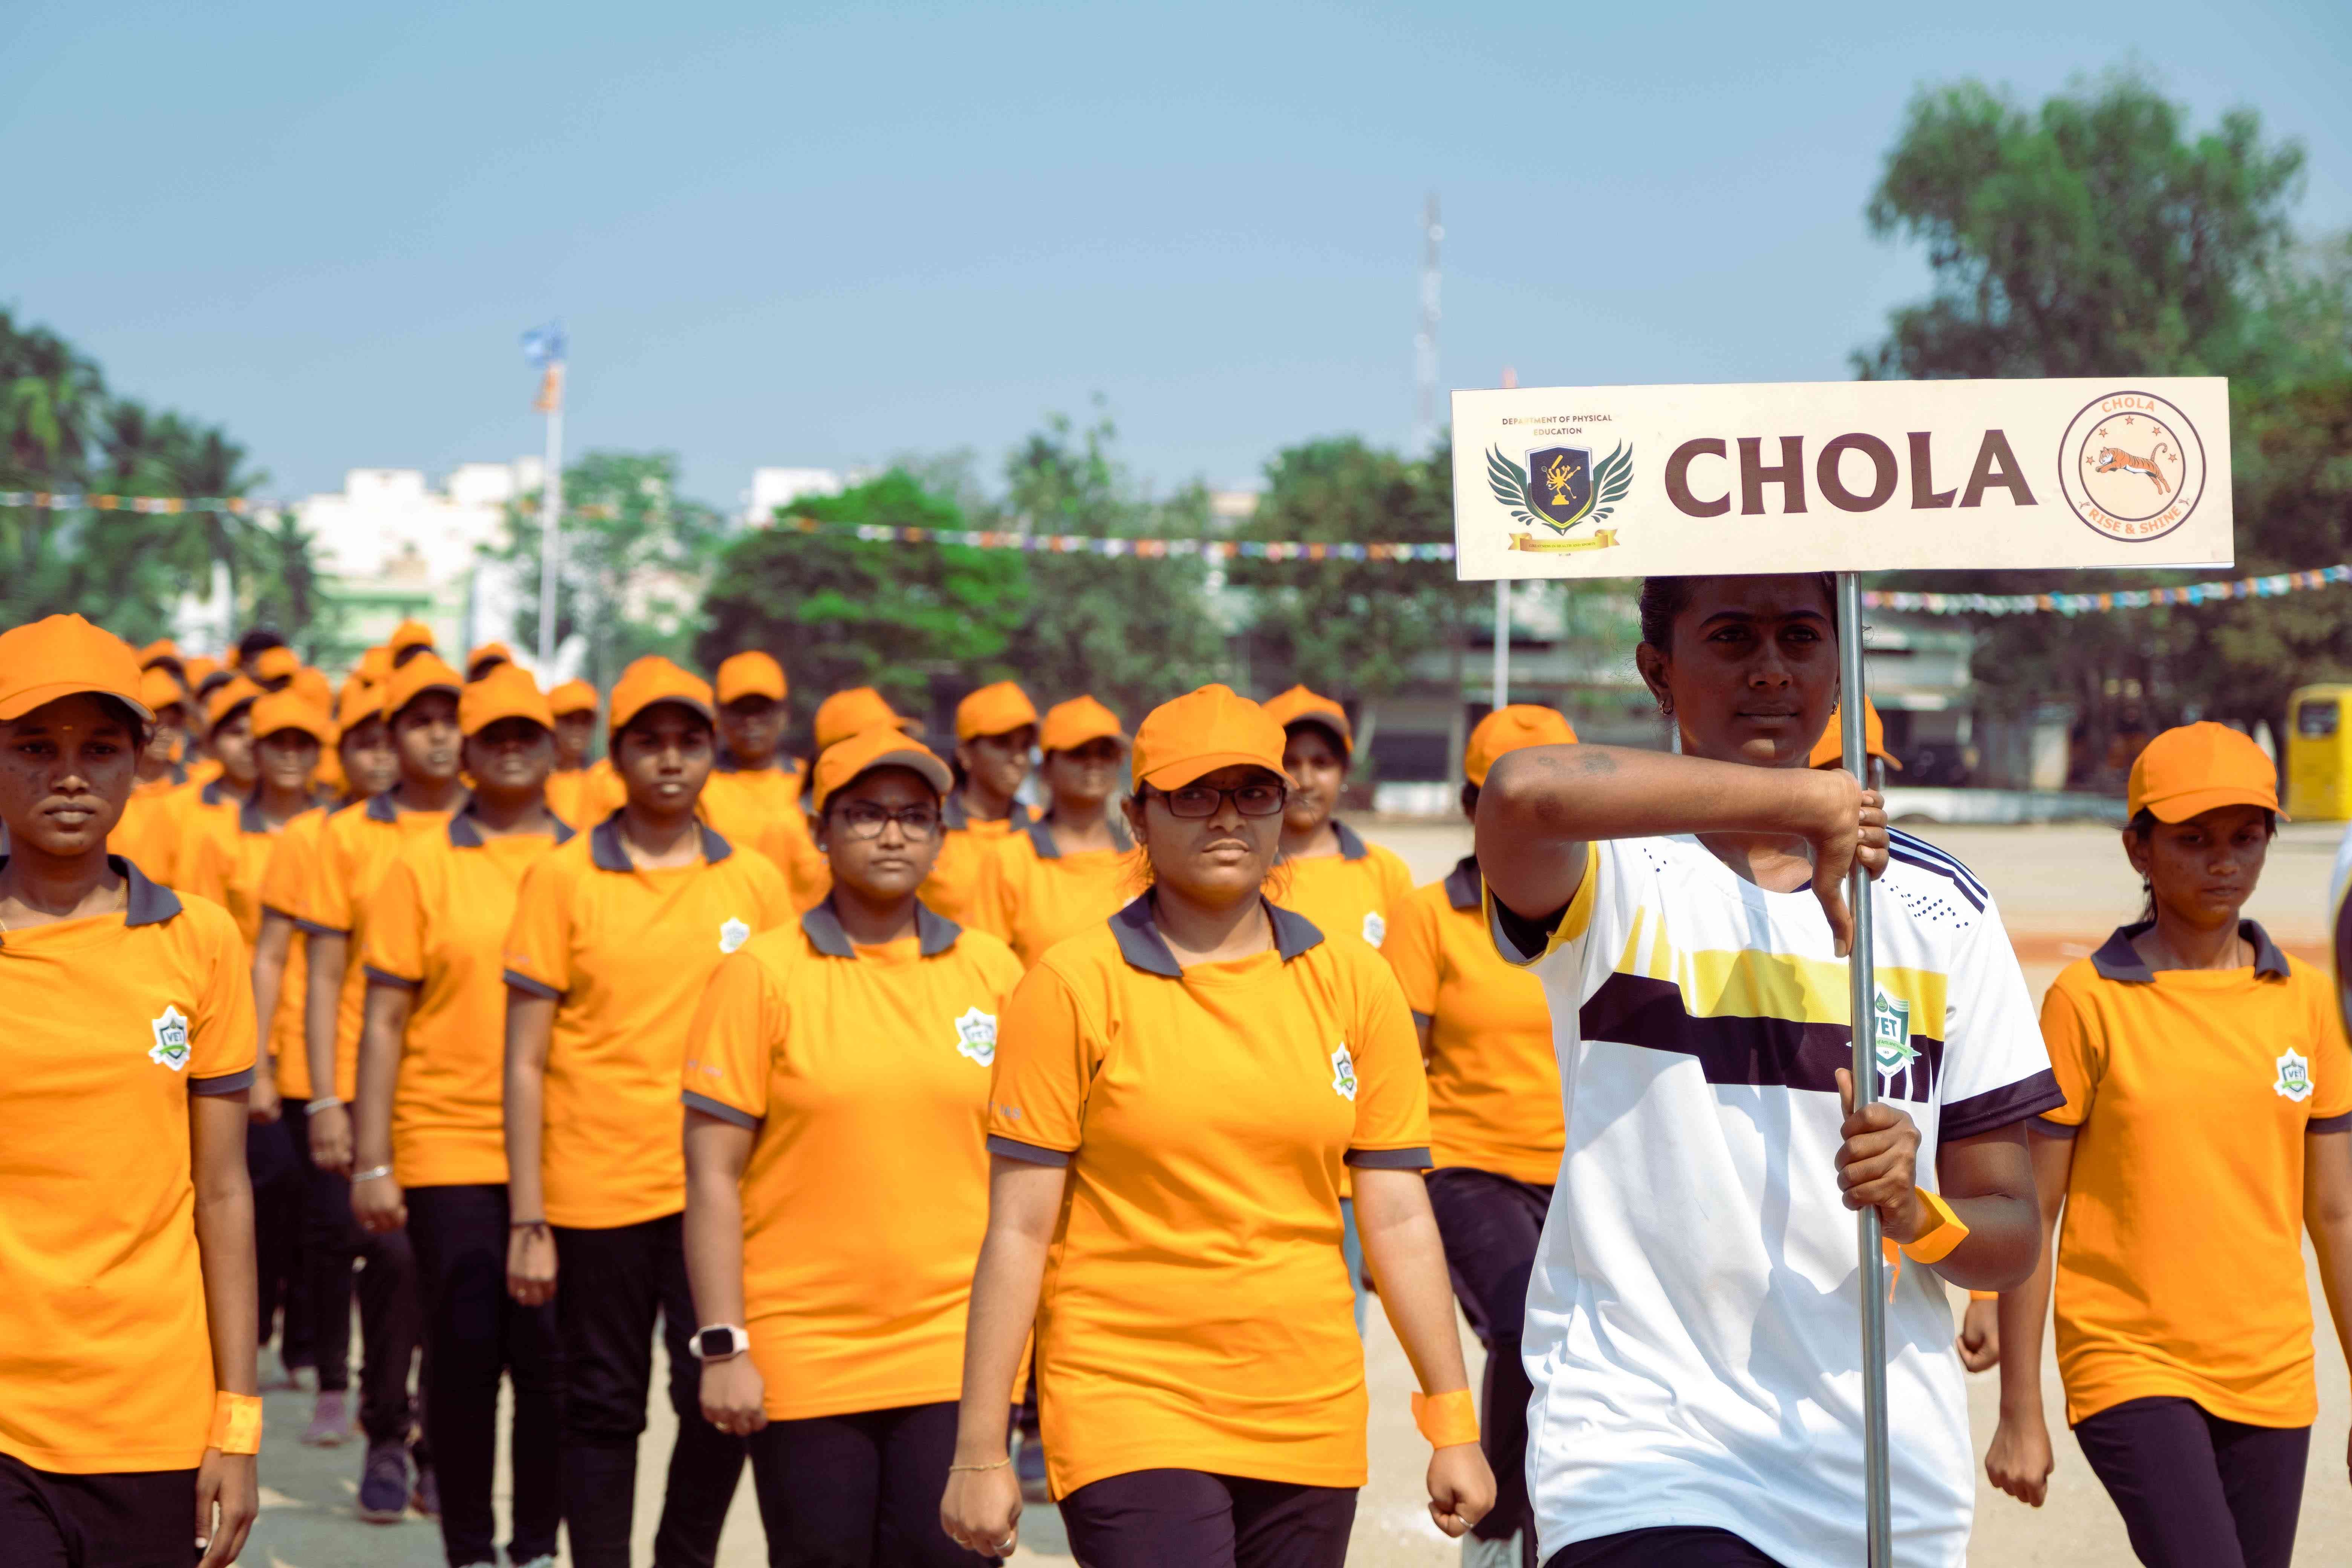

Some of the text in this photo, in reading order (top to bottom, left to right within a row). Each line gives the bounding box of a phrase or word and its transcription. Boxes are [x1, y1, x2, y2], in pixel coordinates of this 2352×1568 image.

[2102, 397, 2155, 412] CHOLA
[1533, 427, 1582, 436] EDUCATION
[1665, 429, 2039, 518] CHOLA
[2088, 506, 2182, 534] RISE & SHINE
